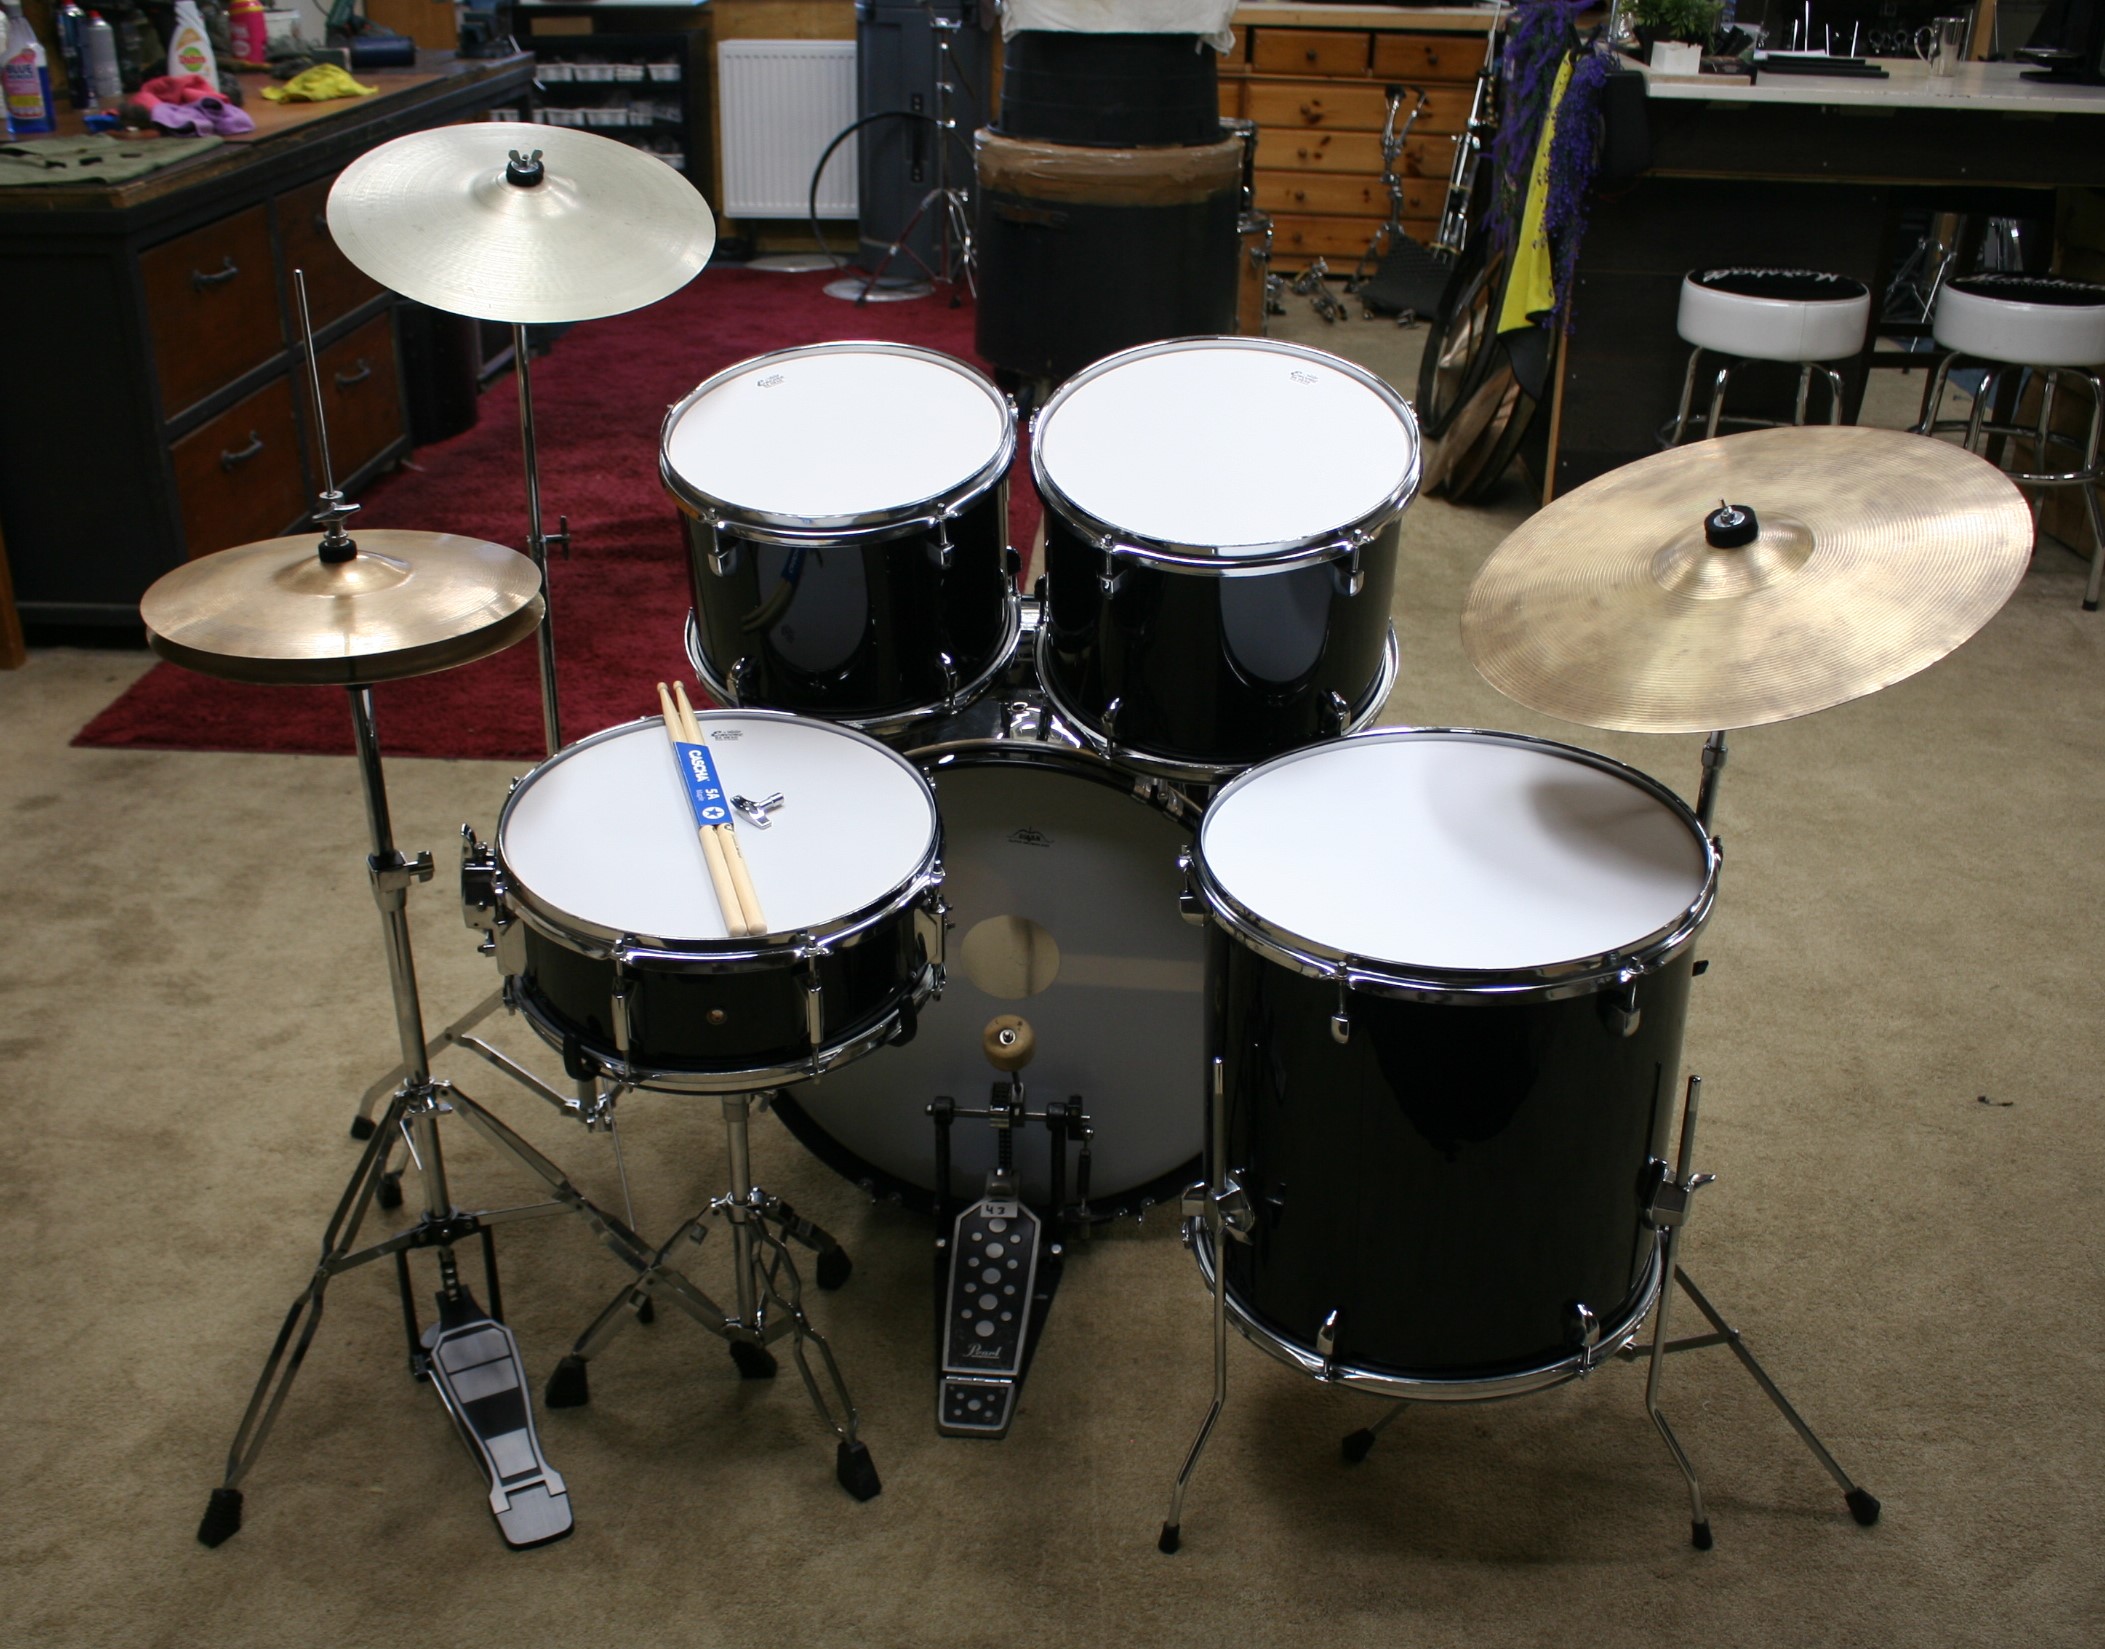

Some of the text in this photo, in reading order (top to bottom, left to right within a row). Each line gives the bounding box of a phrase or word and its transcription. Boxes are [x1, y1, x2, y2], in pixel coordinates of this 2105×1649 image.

[6, 64, 32, 73] BLUE
[689, 749, 709, 783] CASCHA
[986, 1204, 1006, 1215] 43
[963, 1343, 1002, 1357] Pearl
